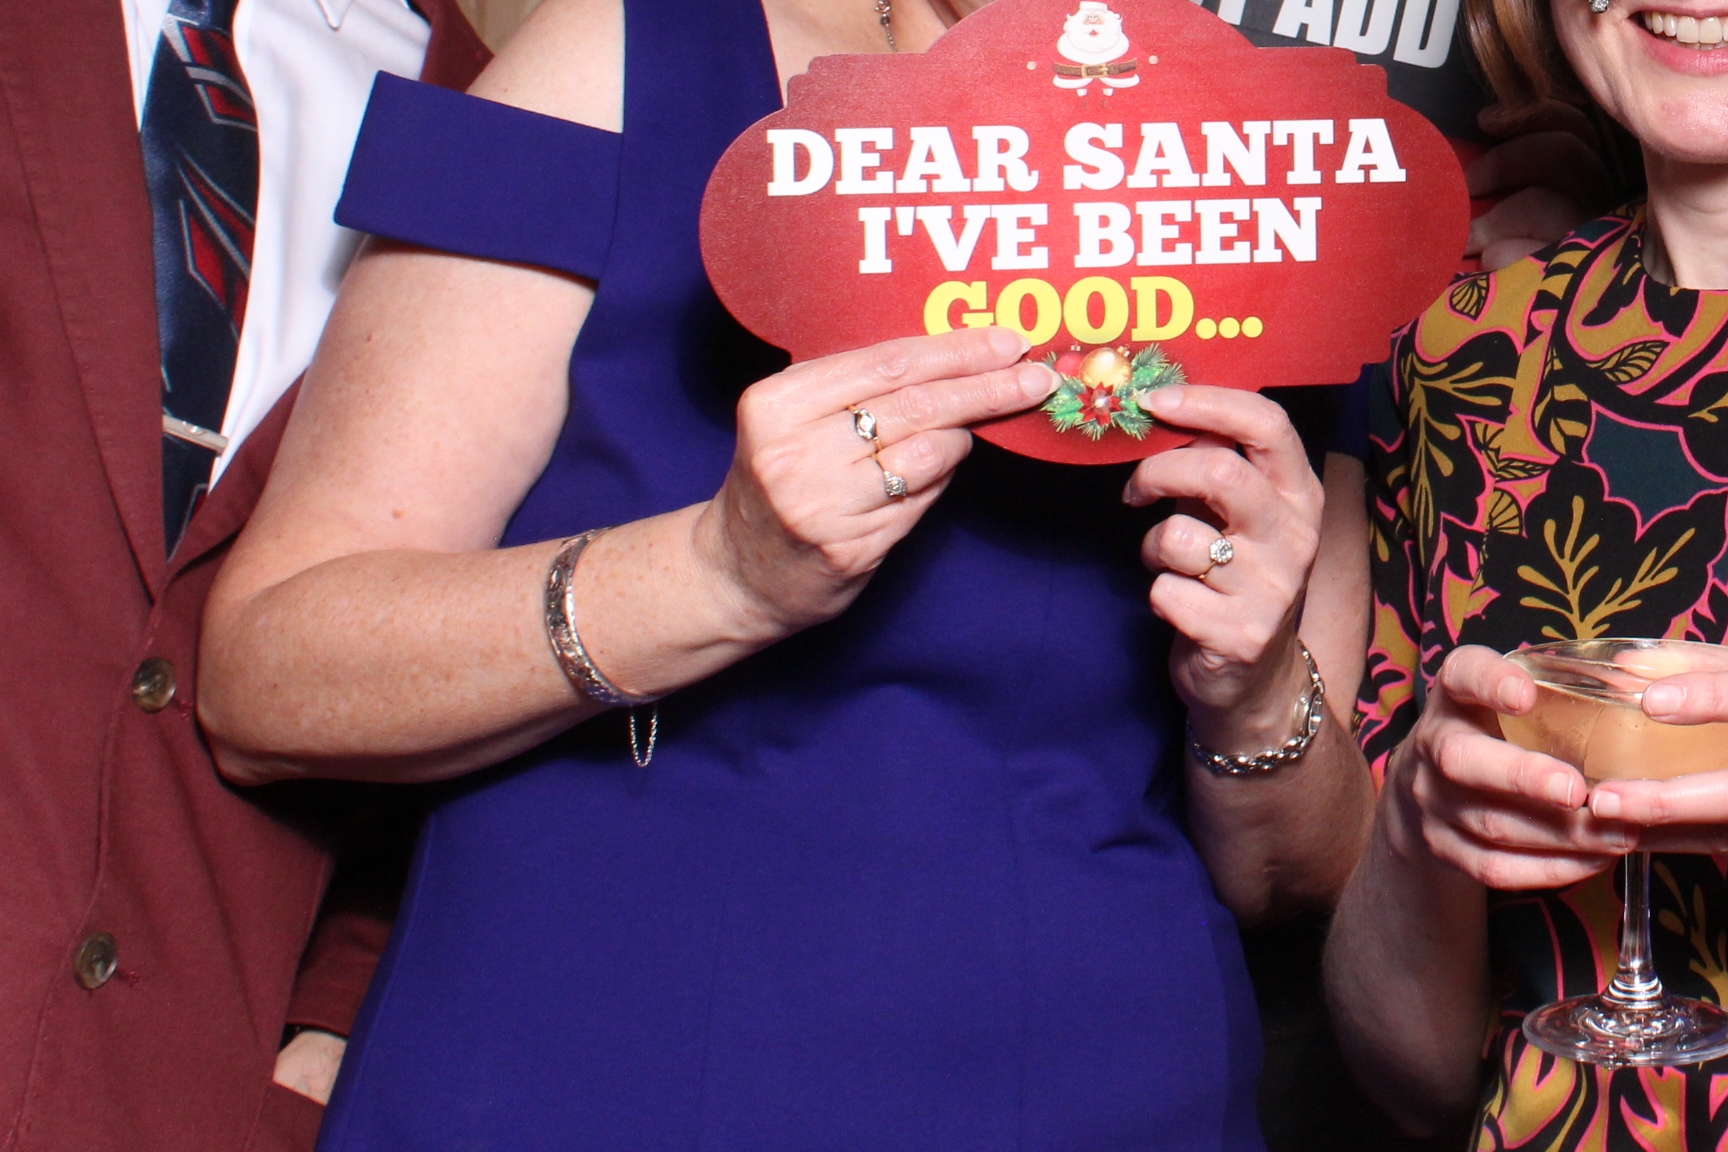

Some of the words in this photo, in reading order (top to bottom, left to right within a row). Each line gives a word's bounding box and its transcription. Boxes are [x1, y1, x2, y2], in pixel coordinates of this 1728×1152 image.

[766, 125, 1039, 196] DEAR
[1063, 118, 1406, 191] SANTA
[858, 203, 1049, 274] I'VE
[1073, 197, 1322, 268] BEEN
[923, 276, 1264, 347] GOOD...
